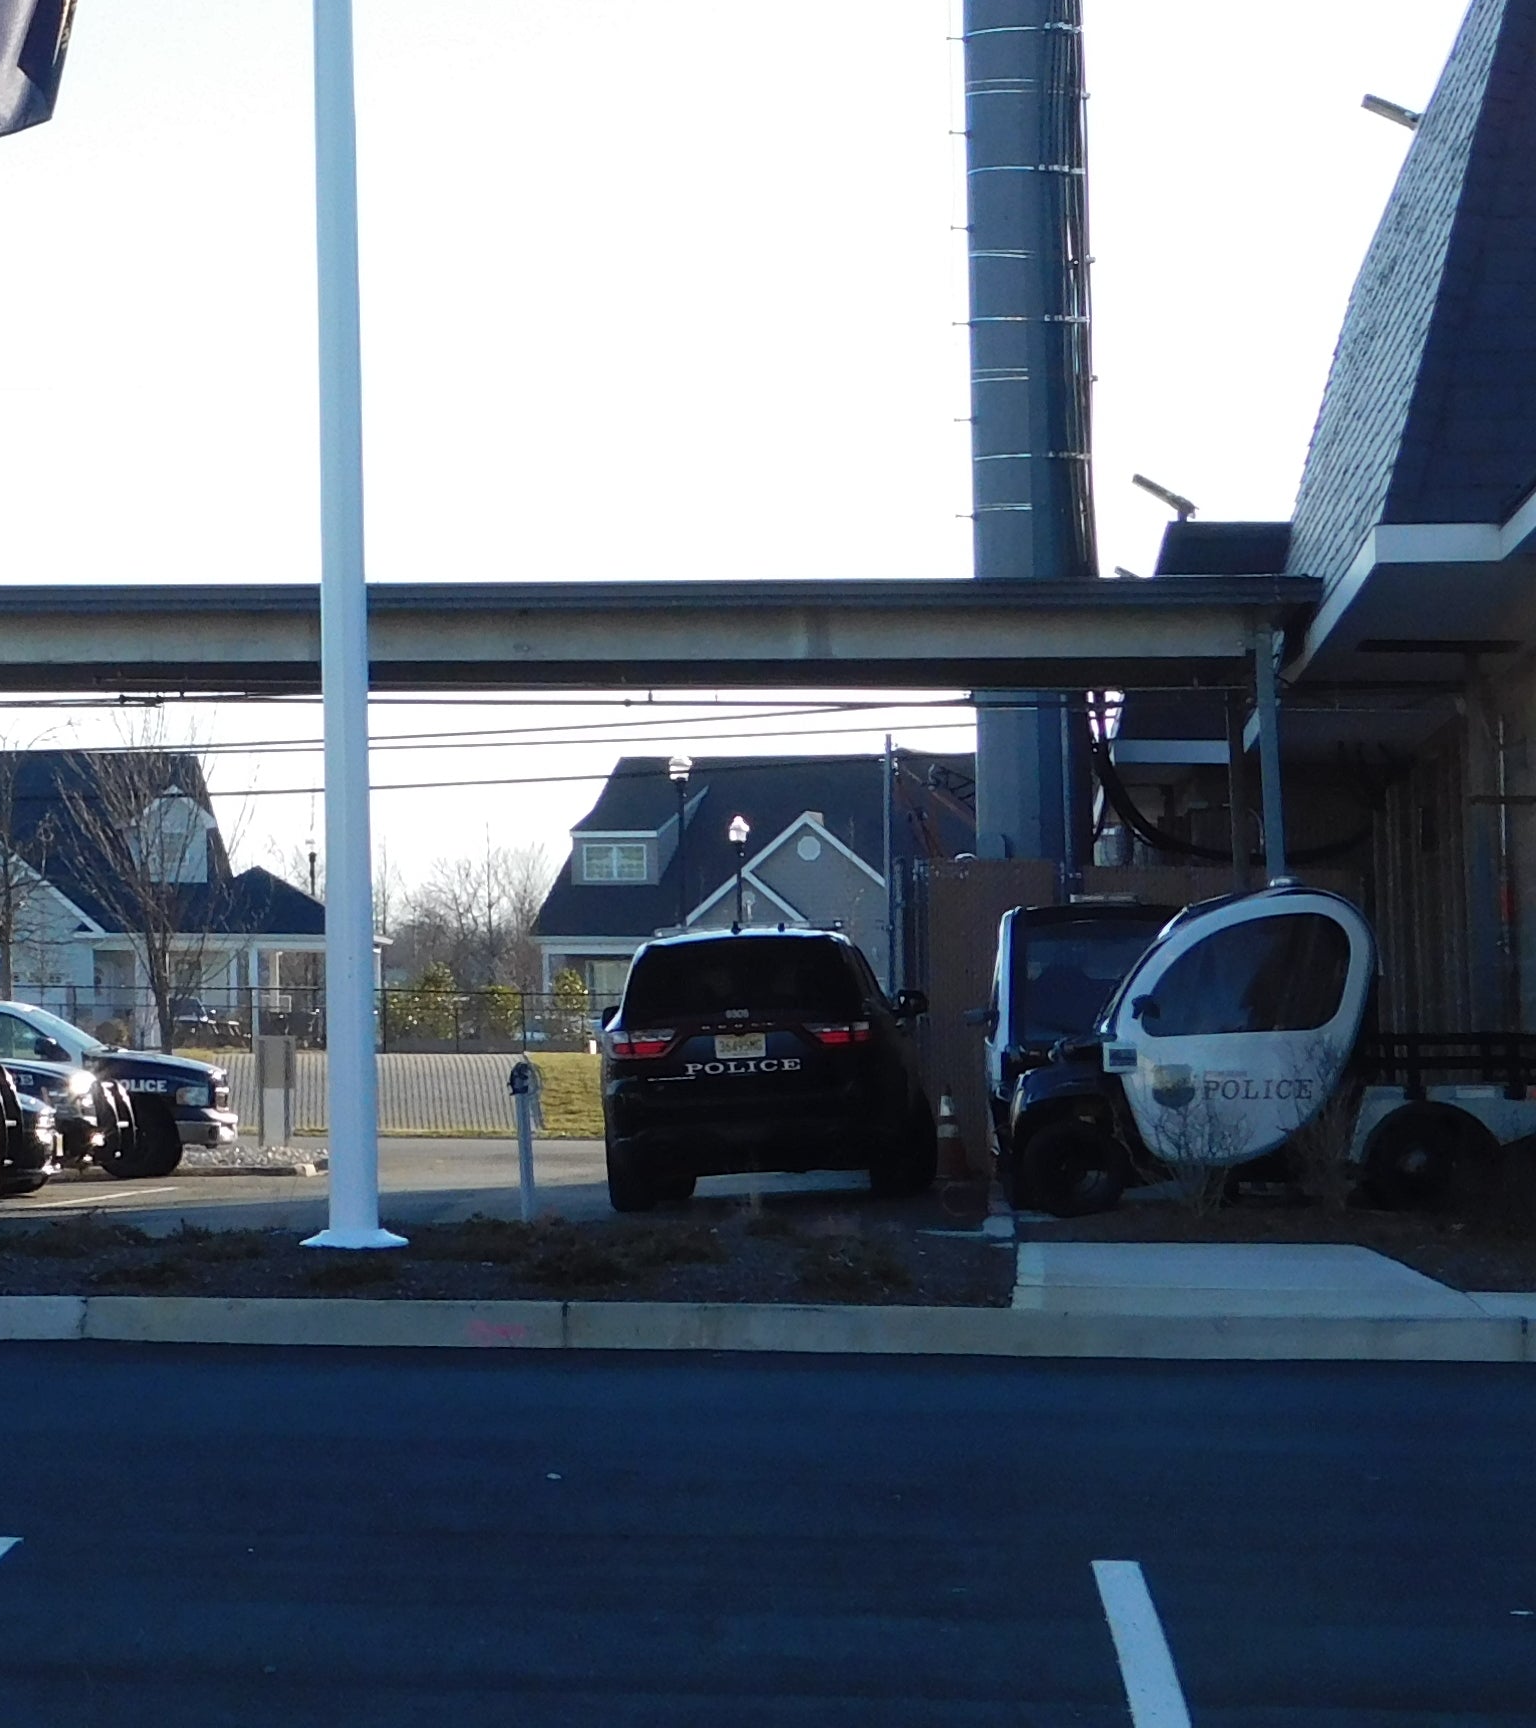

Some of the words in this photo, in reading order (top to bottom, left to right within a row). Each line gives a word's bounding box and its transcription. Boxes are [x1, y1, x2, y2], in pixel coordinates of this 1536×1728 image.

[684, 1058, 801, 1076] POLICE
[119, 1078, 168, 1093] OLICE
[1203, 1078, 1314, 1101] POLICE
